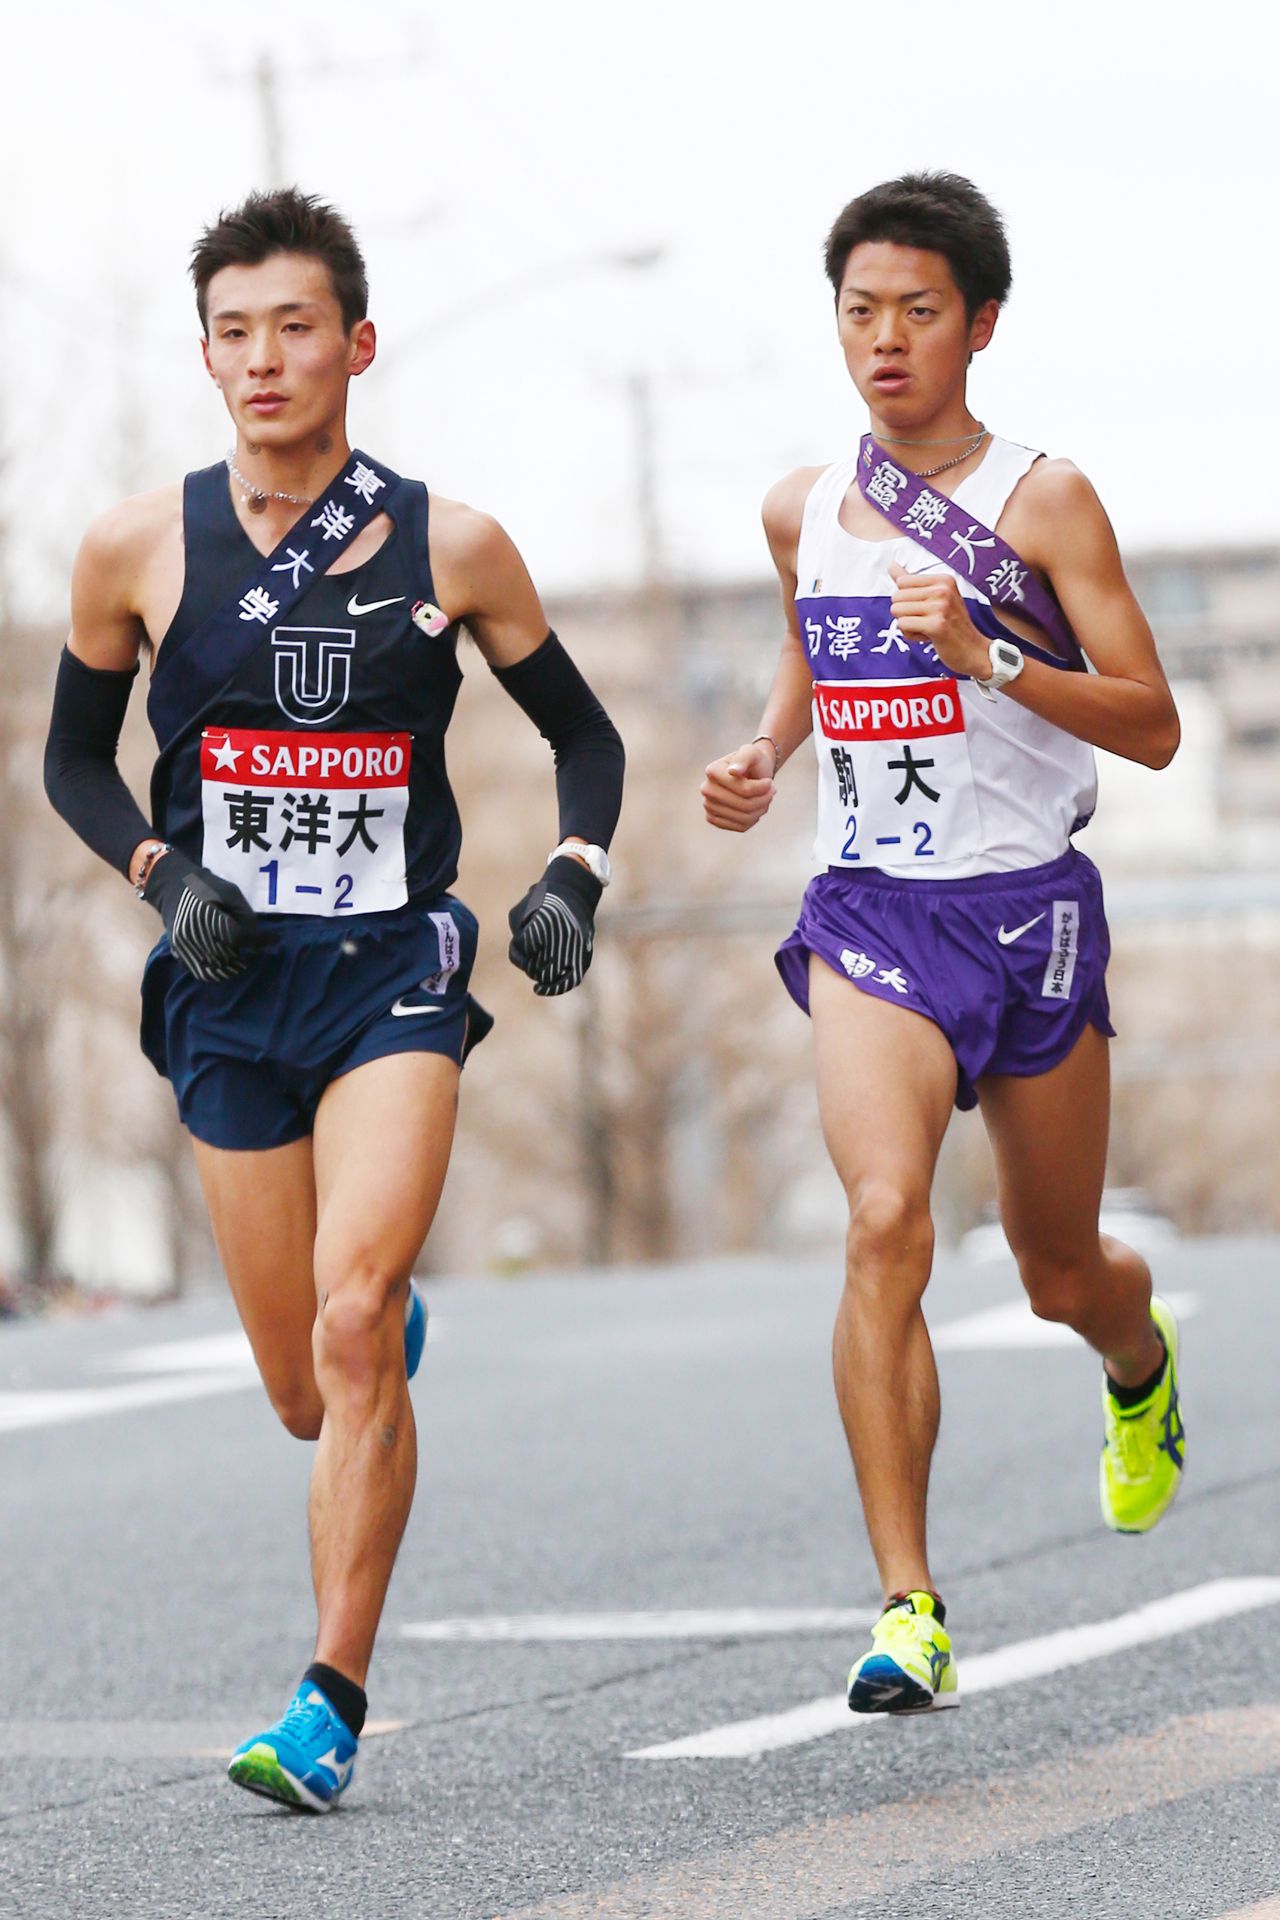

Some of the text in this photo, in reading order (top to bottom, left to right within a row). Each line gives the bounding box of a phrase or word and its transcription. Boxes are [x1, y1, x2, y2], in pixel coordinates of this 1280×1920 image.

[238, 461, 387, 624] 東洋大学
[804, 615, 942, 662] 澤大
[831, 693, 955, 730] SAPPORO
[250, 745, 404, 778] SAPPORO
[830, 744, 941, 808] 駒大
[223, 790, 385, 858] 東洋大
[840, 814, 935, 860] 2-2
[259, 859, 354, 910] 1-2
[839, 948, 909, 994] 駒大
